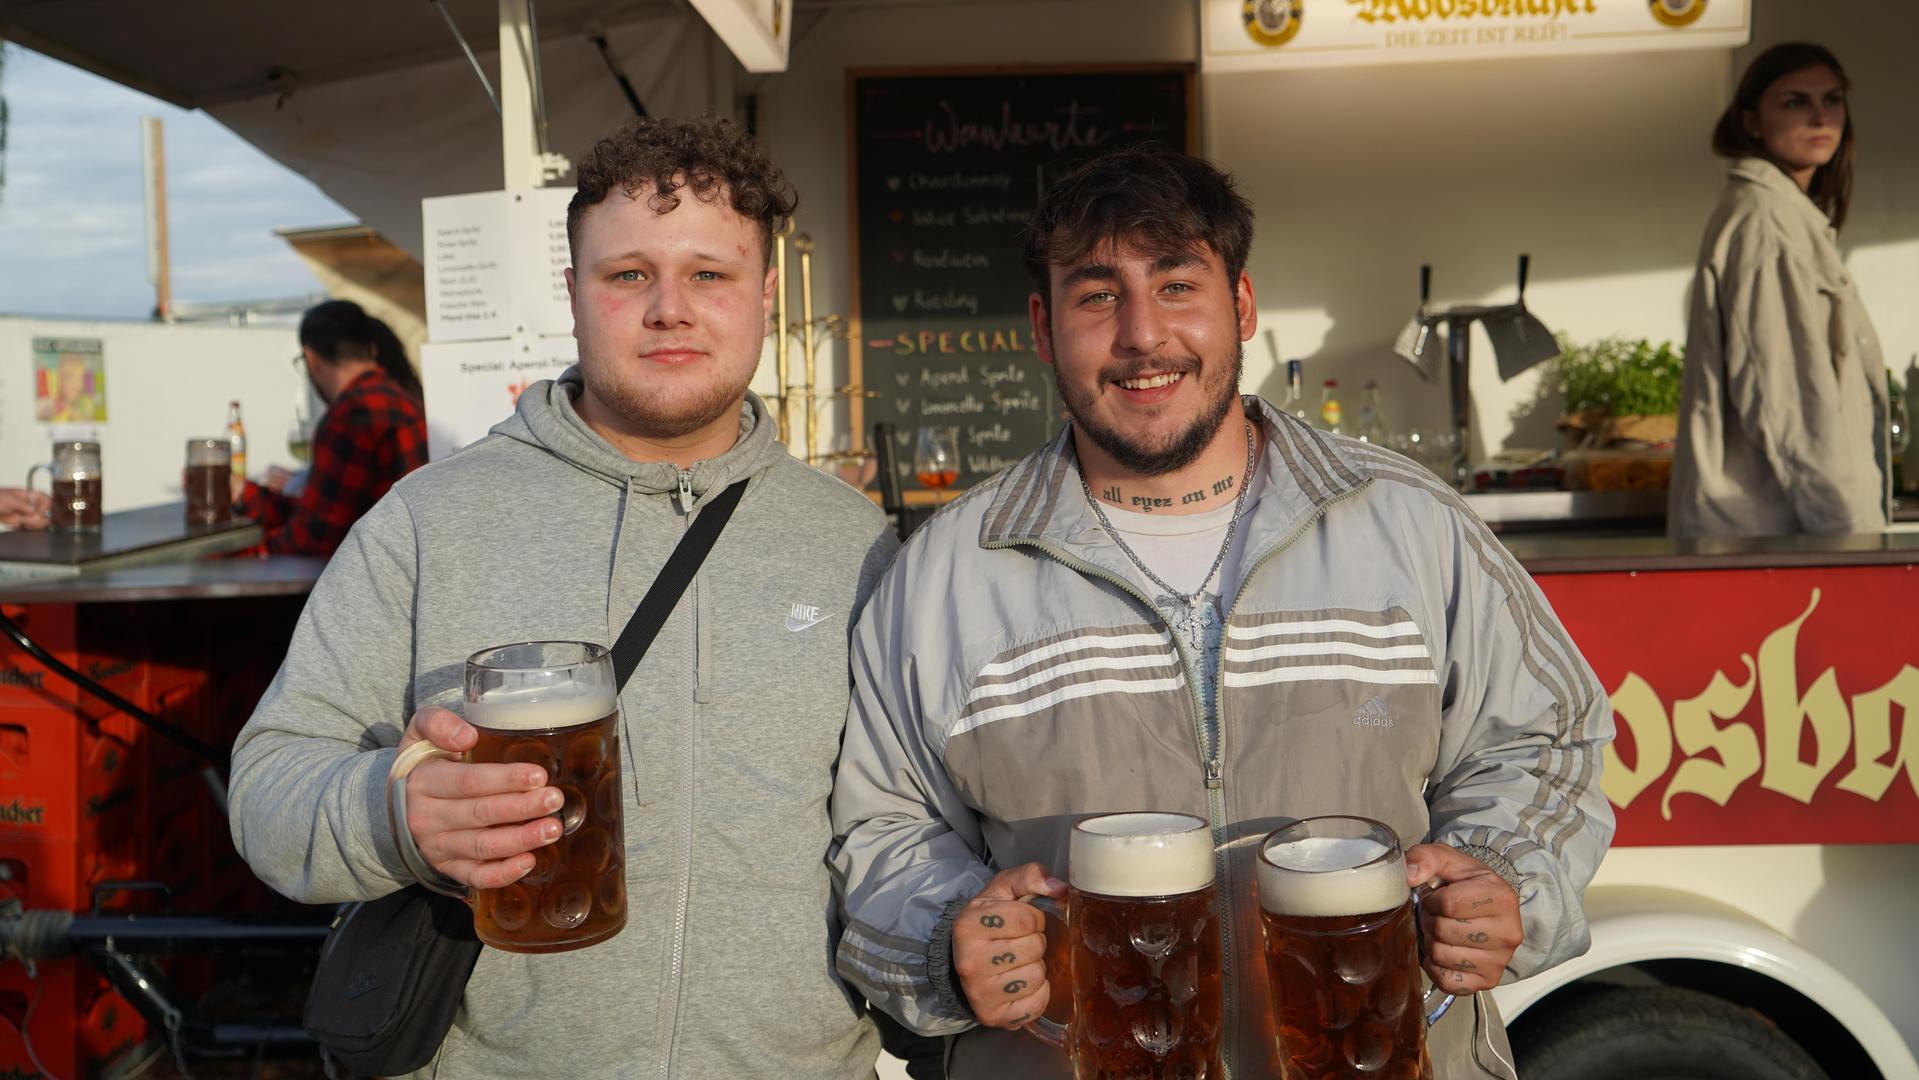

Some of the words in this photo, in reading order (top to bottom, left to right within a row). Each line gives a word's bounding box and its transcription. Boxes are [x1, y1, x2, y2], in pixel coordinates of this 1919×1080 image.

[1385, 31, 1419, 48] DIE
[1425, 28, 1470, 46] ZEIT
[1477, 27, 1506, 44] IST
[1103, 486, 1122, 504] all
[1131, 495, 1173, 513] eyez
[1182, 489, 1207, 505] on
[1212, 475, 1235, 496] me
[790, 602, 820, 622] NIKE
[1352, 713, 1394, 728] adidas
